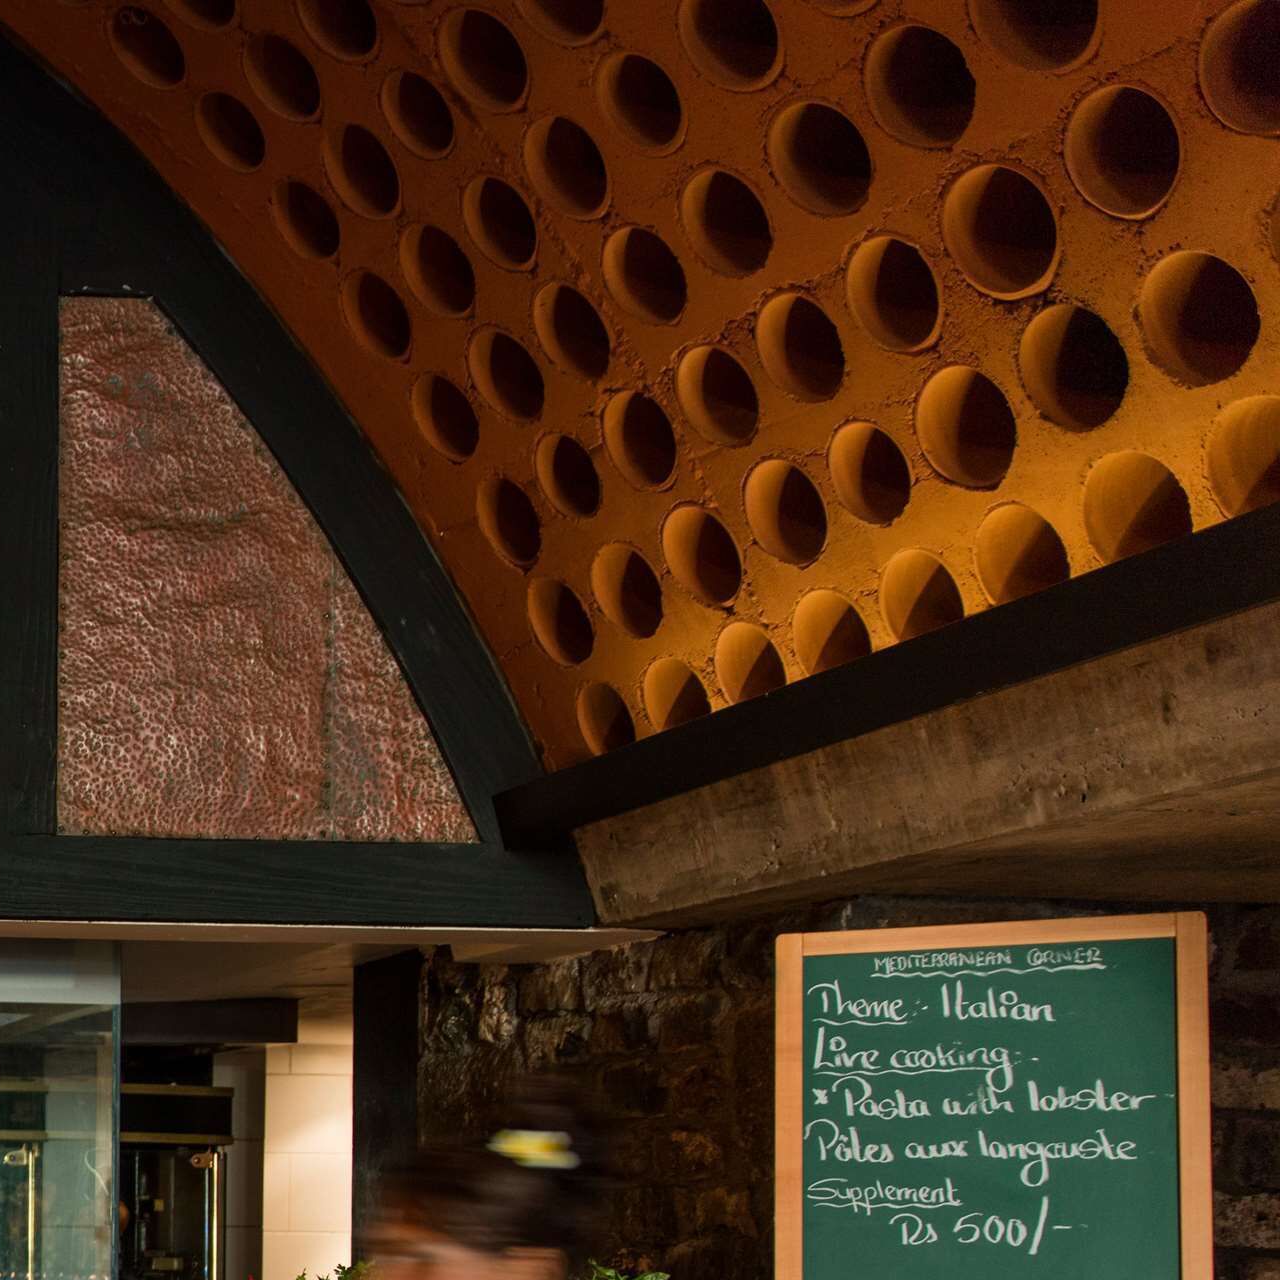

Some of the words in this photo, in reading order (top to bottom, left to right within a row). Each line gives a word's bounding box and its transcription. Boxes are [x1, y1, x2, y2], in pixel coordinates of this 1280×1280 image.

[1027, 946, 1104, 966] CORNER
[942, 979, 1056, 1021] Italian
[813, 1026, 881, 1069] Live
[832, 1076, 931, 1119] Pasta
[942, 1084, 1015, 1115] with
[1027, 1079, 1158, 1111] lobster
[905, 1140, 968, 1159] aux
[807, 1178, 961, 1216] Supplement
[890, 1213, 939, 1245] Rs
